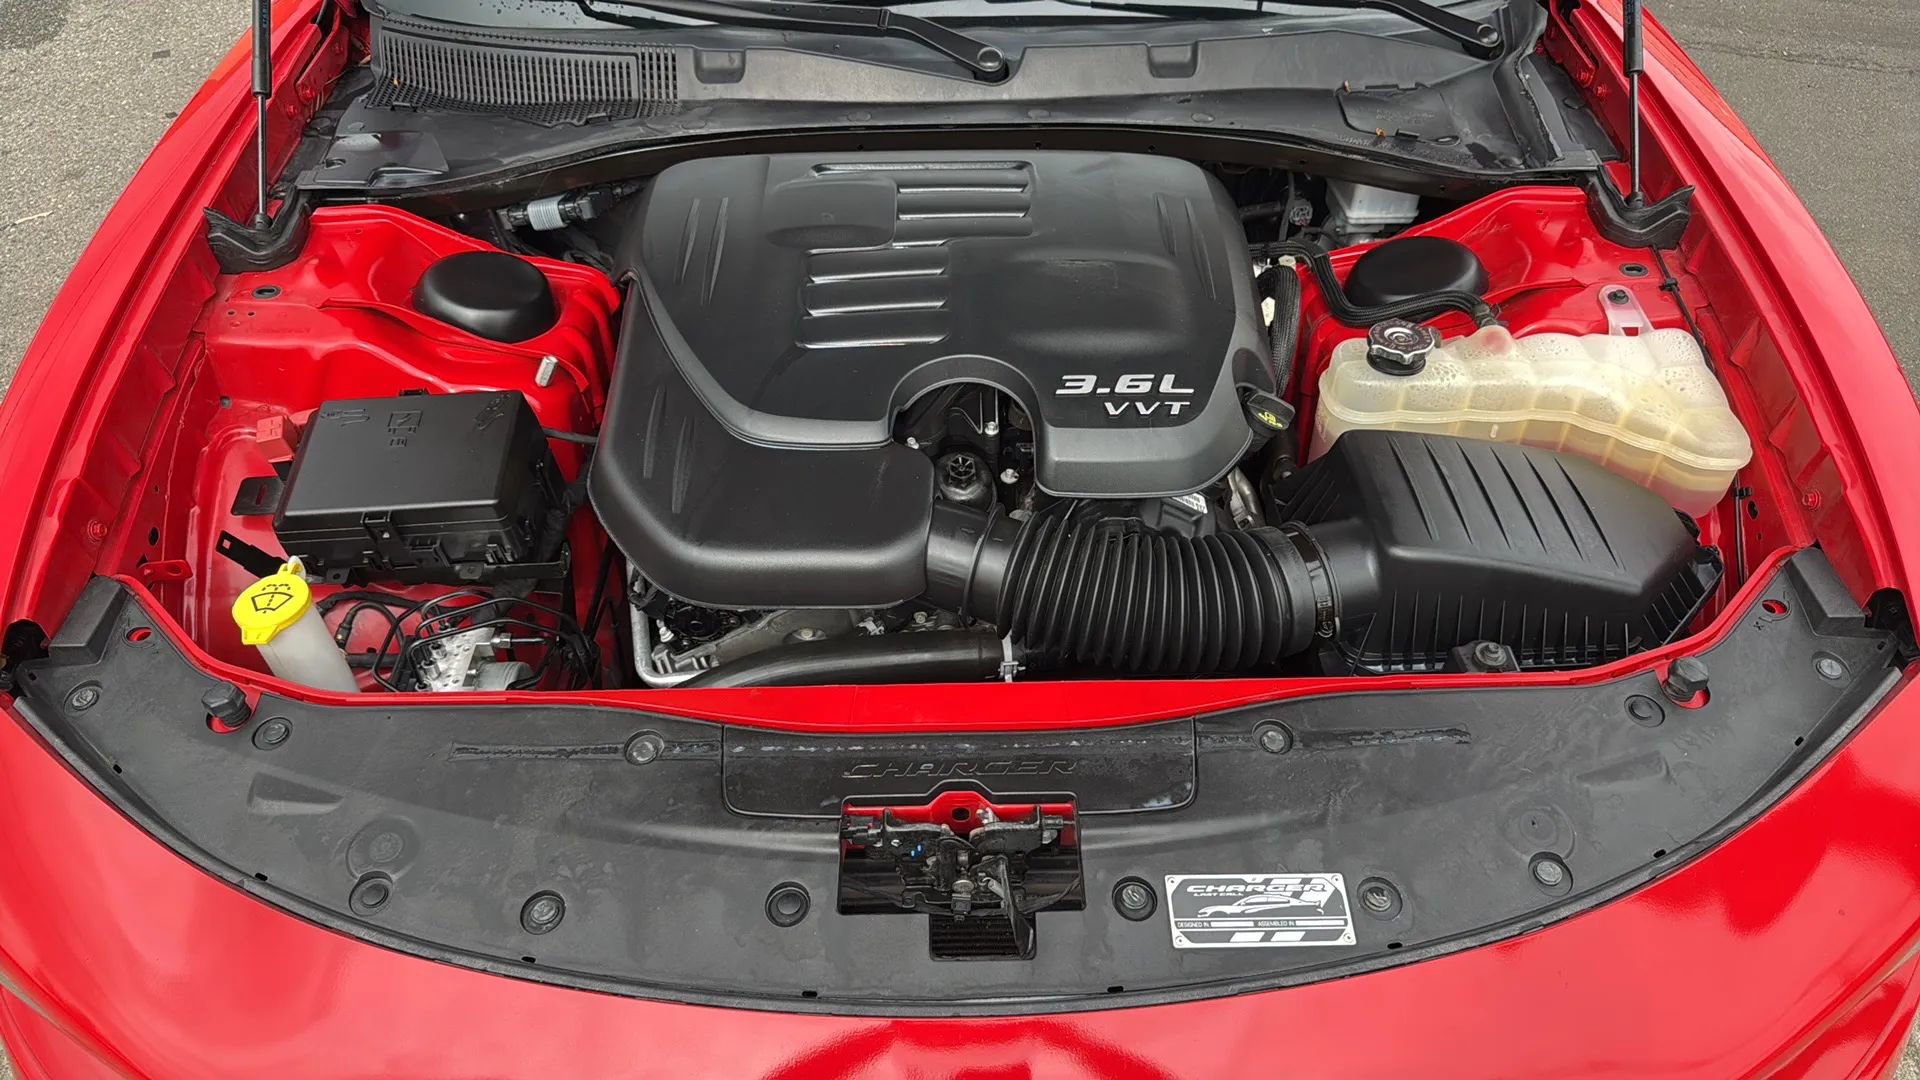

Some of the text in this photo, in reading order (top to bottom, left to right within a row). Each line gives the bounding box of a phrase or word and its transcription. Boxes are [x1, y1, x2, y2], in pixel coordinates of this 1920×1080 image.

[1055, 373, 1195, 395] 3.6L
[1103, 401, 1191, 416] VVT
[842, 760, 1078, 778] CHARGER
[1187, 883, 1328, 893] CHARGER
